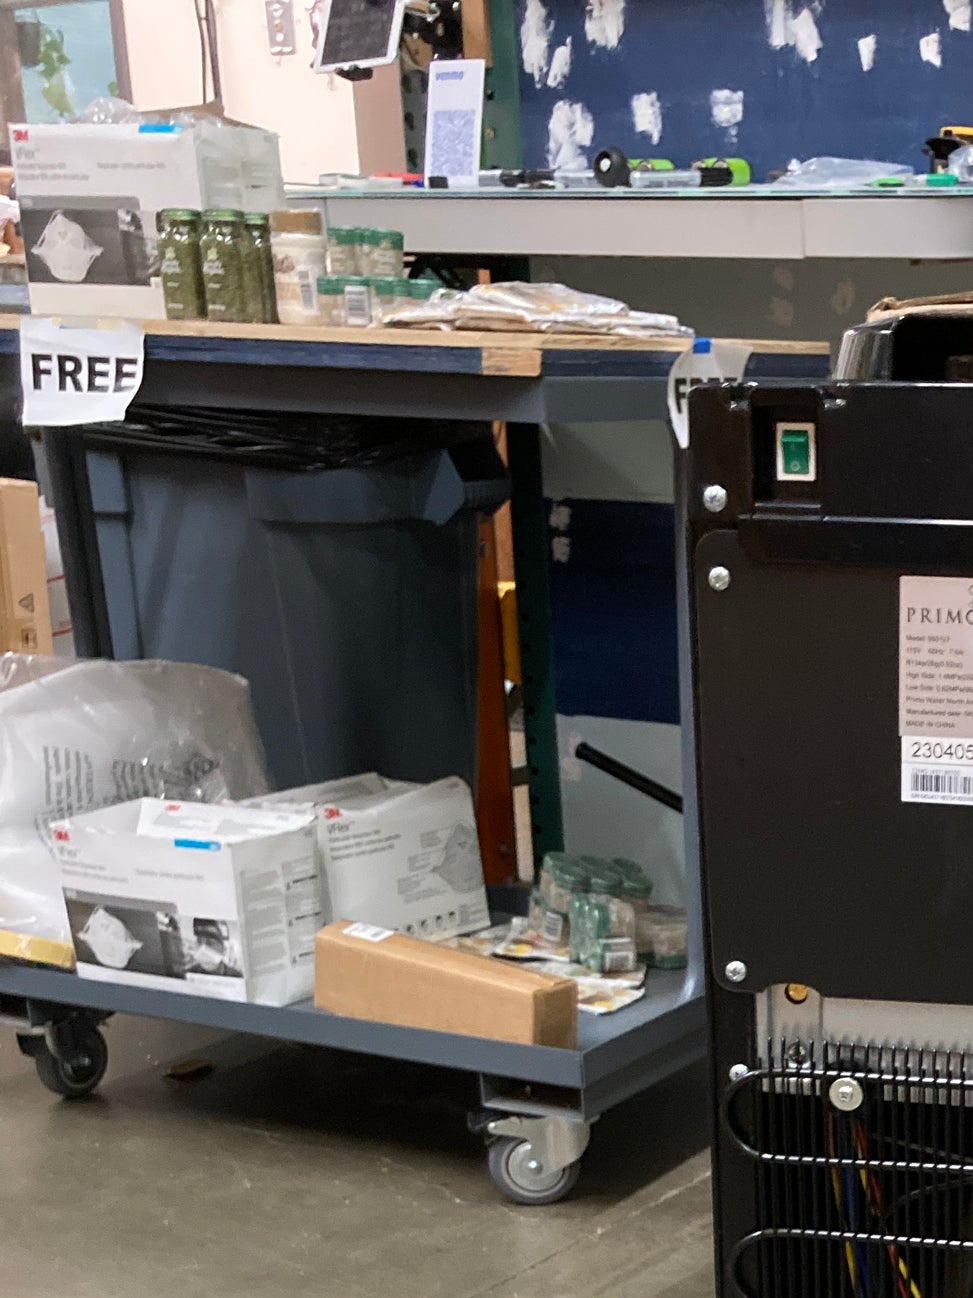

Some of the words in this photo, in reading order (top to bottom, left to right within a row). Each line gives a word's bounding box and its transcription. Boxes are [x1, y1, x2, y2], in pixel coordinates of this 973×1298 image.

[12, 130, 29, 142] 3M
[31, 353, 138, 392] FREE
[324, 808, 342, 819] 3M
